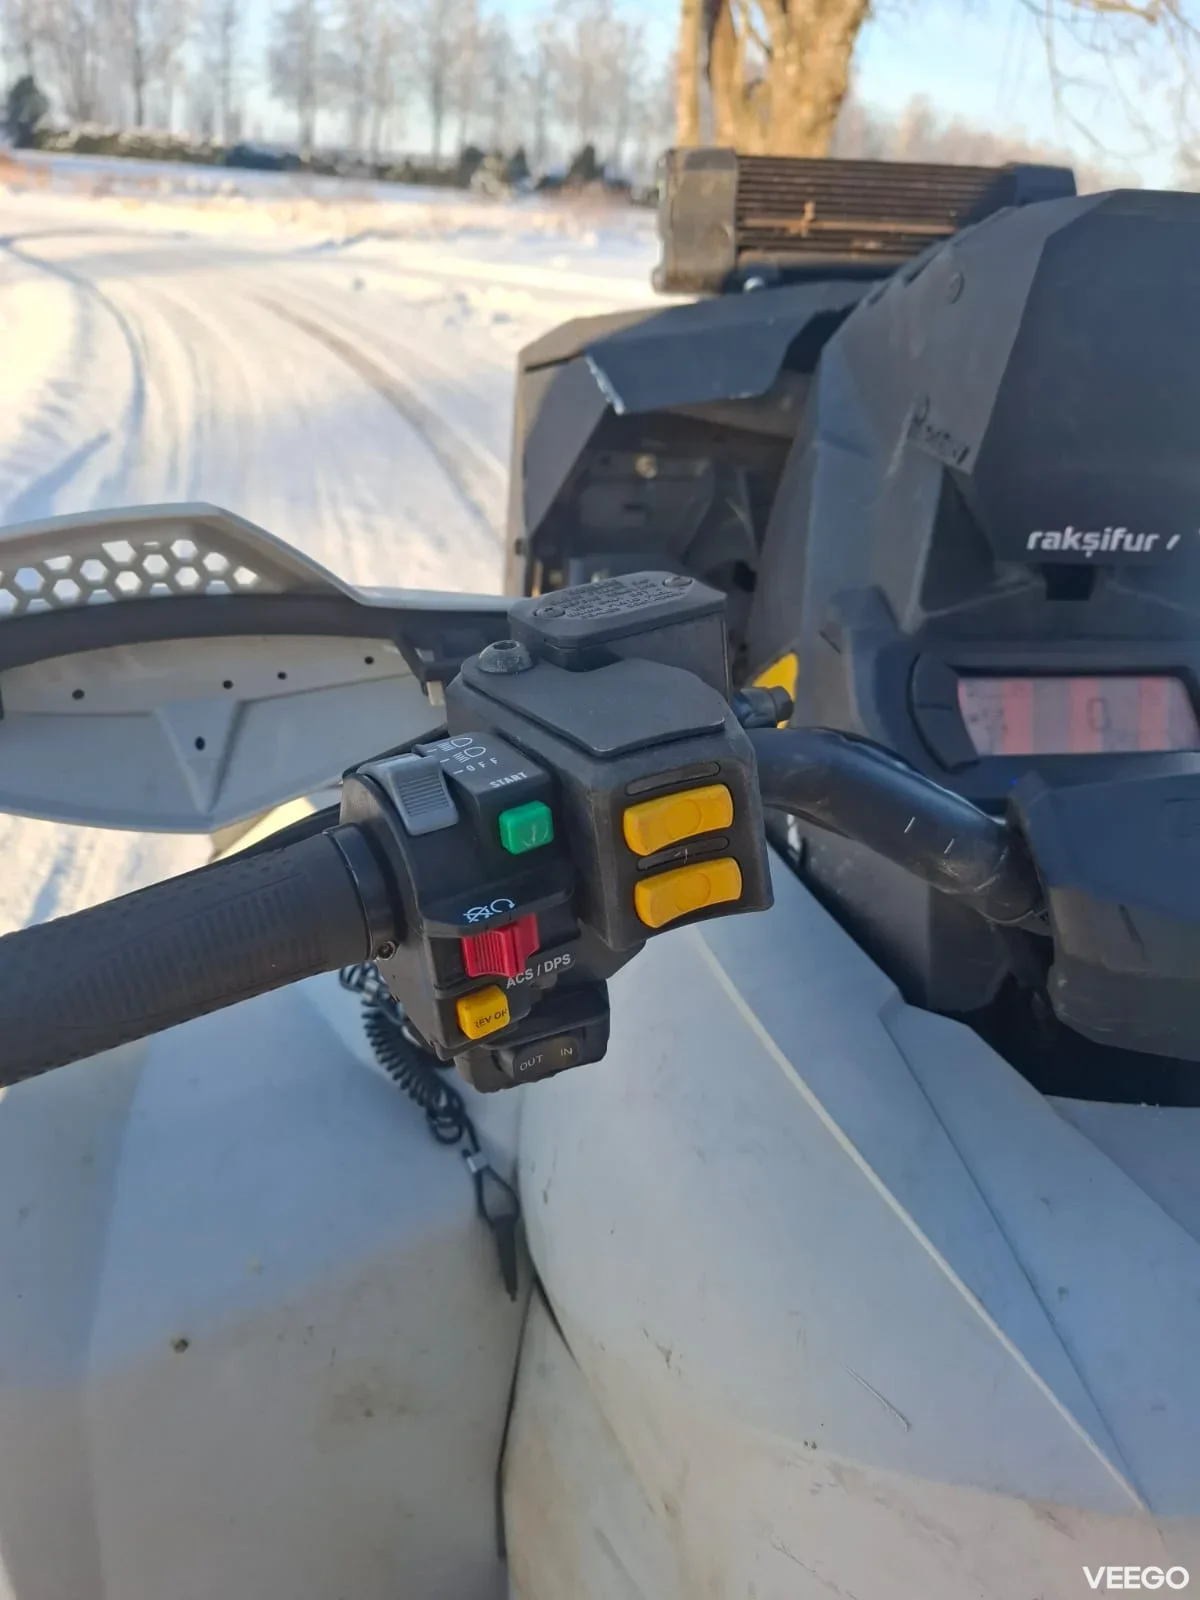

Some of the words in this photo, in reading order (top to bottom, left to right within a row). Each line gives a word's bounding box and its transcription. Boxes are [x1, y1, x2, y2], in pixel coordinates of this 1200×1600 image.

[466, 757, 499, 771] OFF
[489, 772, 528, 788] START
[507, 968, 534, 989] ACS
[544, 954, 571, 972] DPS
[519, 1055, 544, 1071] OUT
[560, 1047, 573, 1056] IN
